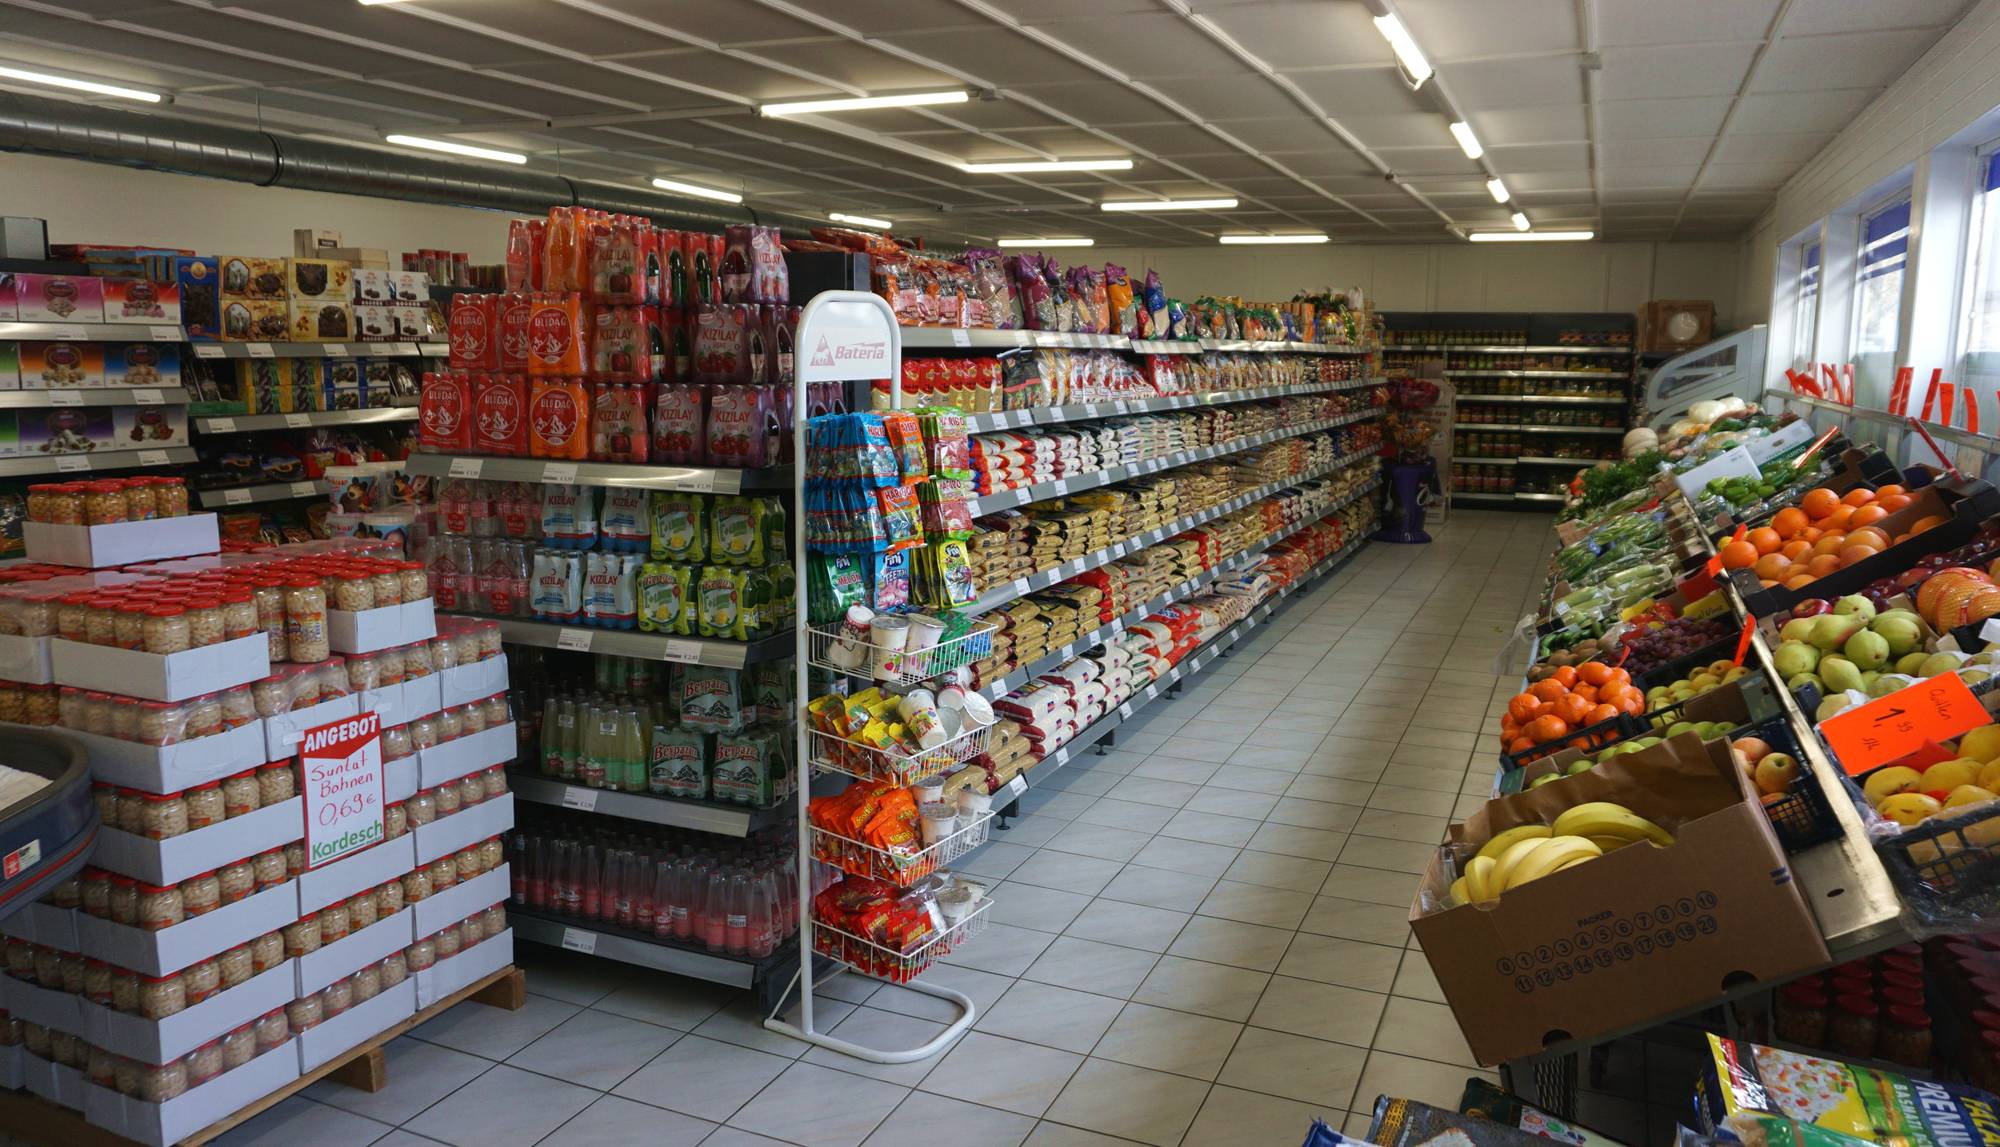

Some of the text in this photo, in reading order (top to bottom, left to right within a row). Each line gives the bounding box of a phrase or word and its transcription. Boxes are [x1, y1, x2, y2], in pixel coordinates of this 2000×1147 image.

[835, 345, 885, 360] Bateria
[660, 408, 694, 421] KIZILAY
[715, 411, 750, 424] KIZILAY
[548, 495, 576, 506] KIZILAY
[884, 485, 912, 501] HARIBO
[540, 575, 565, 587] KIZILAY
[590, 575, 618, 586] KIZILAY
[304, 715, 378, 753] ANGEBOT
[319, 772, 374, 798] Bohnen
[312, 820, 383, 861] Kardesch
[1893, 1084, 1924, 1130] BASMATI
